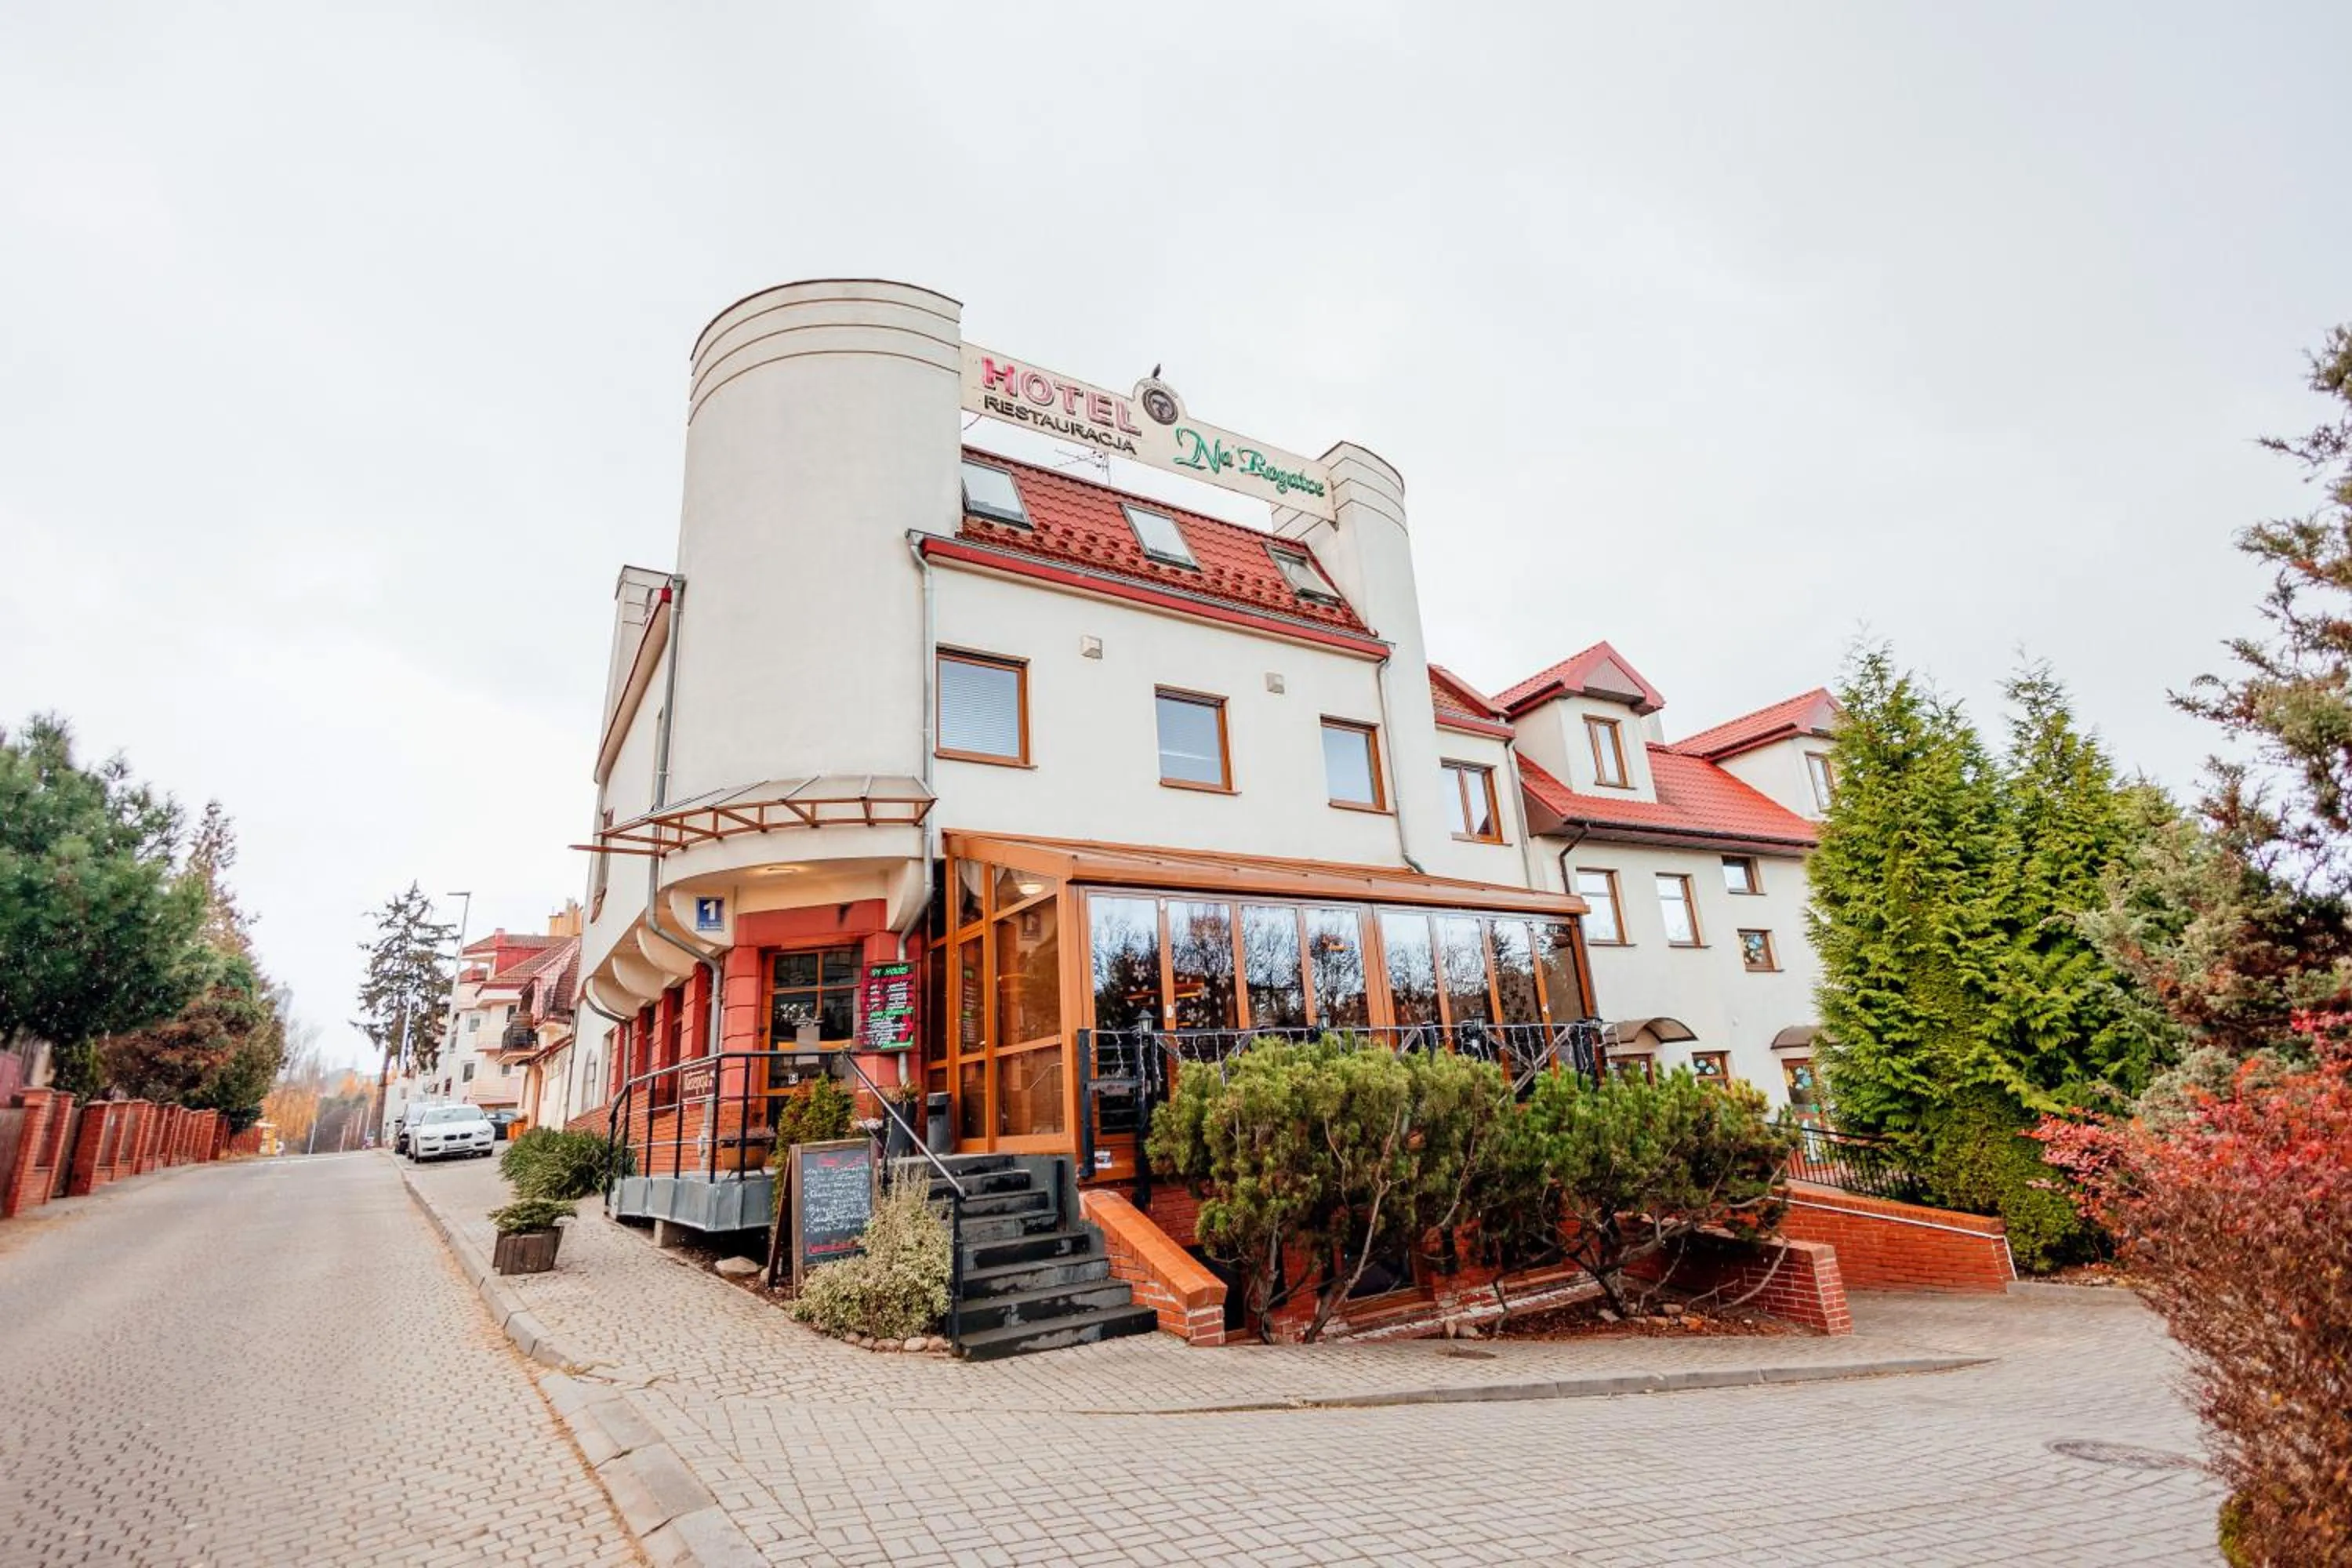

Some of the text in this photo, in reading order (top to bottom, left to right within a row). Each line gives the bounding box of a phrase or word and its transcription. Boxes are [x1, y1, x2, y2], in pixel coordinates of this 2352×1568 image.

[982, 357, 1142, 437] HOTEL
[984, 394, 1137, 455] RESTAURACJA
[1173, 426, 1235, 474] Na
[703, 901, 716, 920] 1
